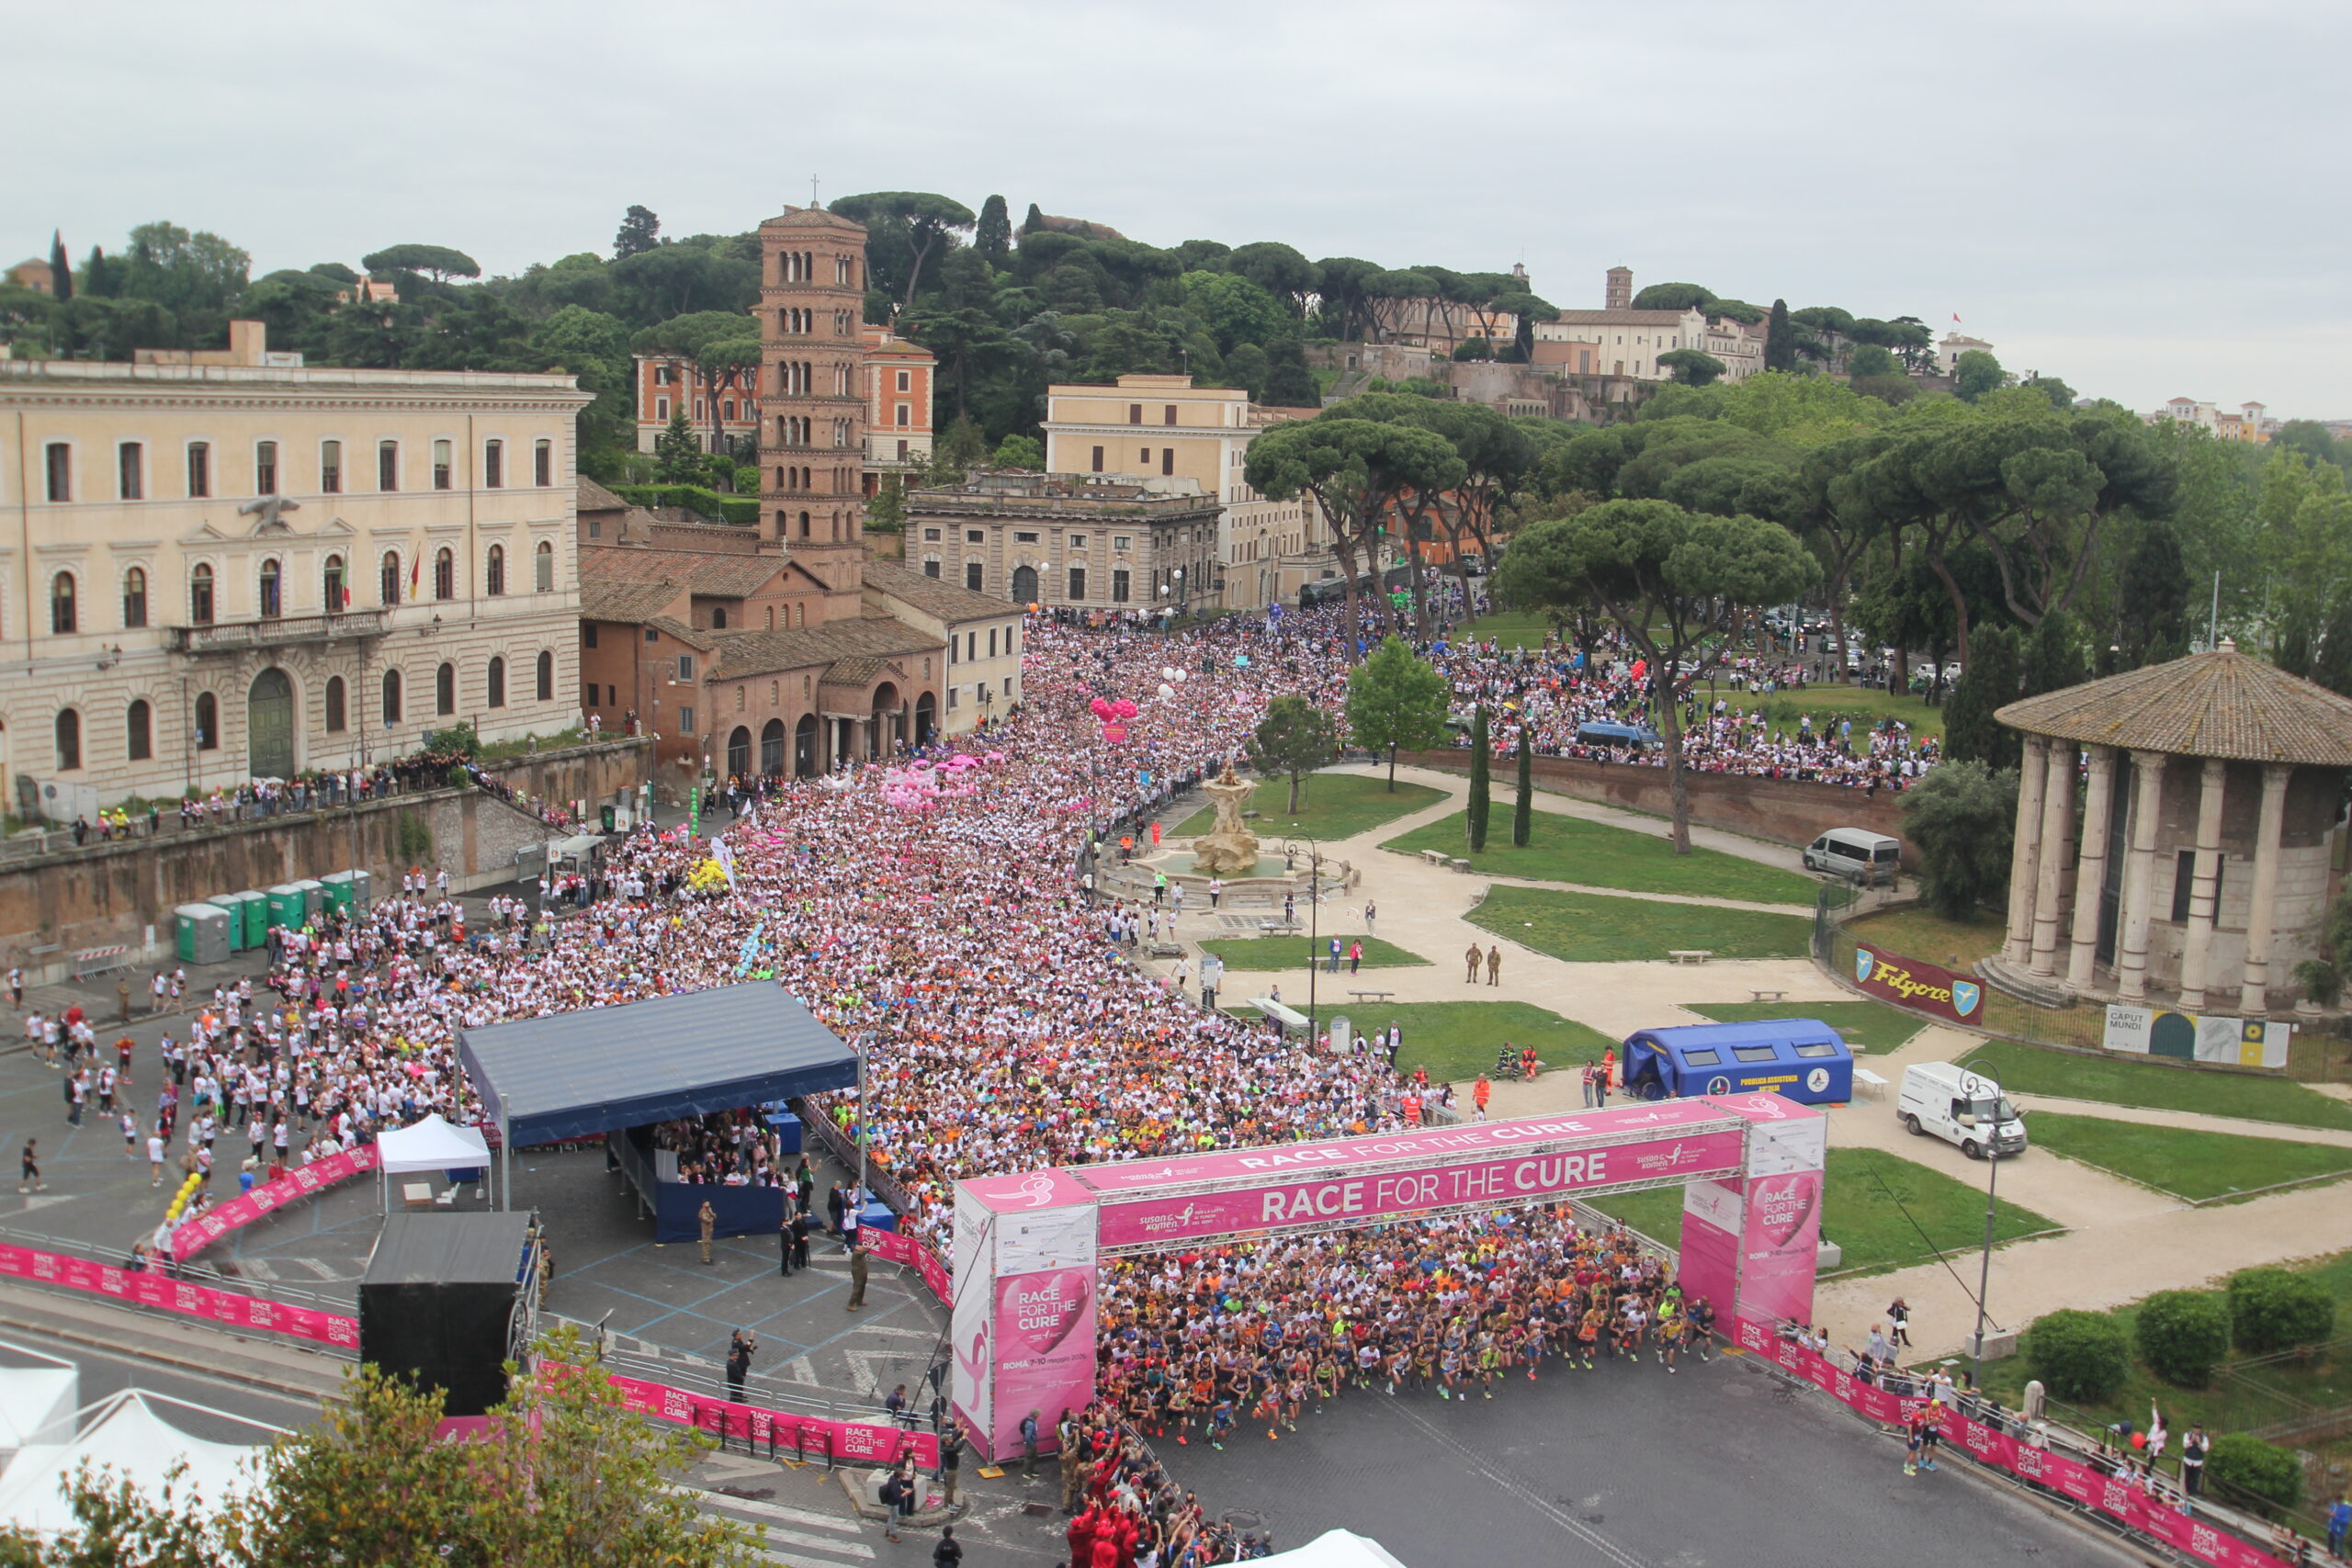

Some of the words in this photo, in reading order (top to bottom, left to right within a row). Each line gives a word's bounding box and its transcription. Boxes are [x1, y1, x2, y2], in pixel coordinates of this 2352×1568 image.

[2110, 1012, 2143, 1022] CAPUT
[2110, 1020, 2142, 1031] MUNDI
[1238, 1148, 1350, 1168] RACE
[1352, 1142, 1424, 1156] FOR
[1421, 1133, 1490, 1147] THE
[1491, 1121, 1592, 1139] CURE
[1262, 1181, 1364, 1222] RACE
[1376, 1174, 1440, 1208] FOR
[1448, 1165, 1506, 1199] THE
[1514, 1152, 1607, 1190] CURE
[1765, 1189, 1795, 1203] RACE
[1764, 1201, 1786, 1214] FOR
[1787, 1199, 1807, 1211] THE
[1763, 1212, 1793, 1225] CURE
[862, 1229, 880, 1238] RACE
[33, 1253, 54, 1264] RACE
[1749, 1251, 1769, 1260] ROMA
[33, 1269, 54, 1279] CURE
[102, 1267, 122, 1278] RACE
[101, 1283, 123, 1293] CURE
[175, 1284, 196, 1295] RACE
[175, 1292, 192, 1303] FOR
[1019, 1289, 1059, 1303] RACE
[175, 1300, 198, 1311] CURE
[250, 1300, 271, 1312] RACE
[1019, 1303, 1047, 1317] FOR
[1050, 1300, 1076, 1313] THE
[250, 1308, 266, 1318] FOR
[250, 1315, 272, 1326] CURE
[1019, 1314, 1059, 1330] CURE
[328, 1325, 345, 1336] FOR
[1743, 1322, 1761, 1336] RACE
[328, 1333, 350, 1343] CURE
[1741, 1337, 1761, 1350] CURE
[1742, 1329, 1757, 1340] FOR
[1756, 1336, 1770, 1348] THE
[1780, 1341, 1797, 1353] RACE
[1002, 1359, 1029, 1371] ROMA
[1029, 1358, 1046, 1366] 7-10
[1047, 1356, 1069, 1364] maggio
[1779, 1356, 1797, 1370] CURE
[1780, 1348, 1793, 1359] FOR
[1792, 1354, 1805, 1366] THE
[1836, 1371, 1851, 1385] RACE
[665, 1390, 687, 1403] RACE
[1836, 1387, 1851, 1402] CURE
[664, 1398, 683, 1410] FOR
[683, 1402, 695, 1413] TH
[664, 1406, 688, 1419] CURE
[845, 1427, 873, 1438] RACE
[1967, 1422, 1989, 1437] RACE
[845, 1437, 866, 1446] FOR
[868, 1438, 886, 1448] THE
[1966, 1438, 1988, 1454] CURE
[1967, 1431, 1984, 1443] FOR
[1984, 1438, 1998, 1451] THE
[845, 1444, 874, 1454] CURE
[2018, 1445, 2042, 1461] RACE
[2018, 1454, 2036, 1466] FOR
[2036, 1461, 2053, 1474] THE
[2018, 1461, 2042, 1477] CURE
[2105, 1481, 2128, 1497] RACE
[2104, 1492, 2122, 1505] FOR
[2103, 1498, 2127, 1516] CURE
[2193, 1524, 2218, 1541] RACE
[2191, 1542, 2217, 1561] CURE
[2192, 1534, 2211, 1549] FOR
[2211, 1540, 2230, 1558] THE
